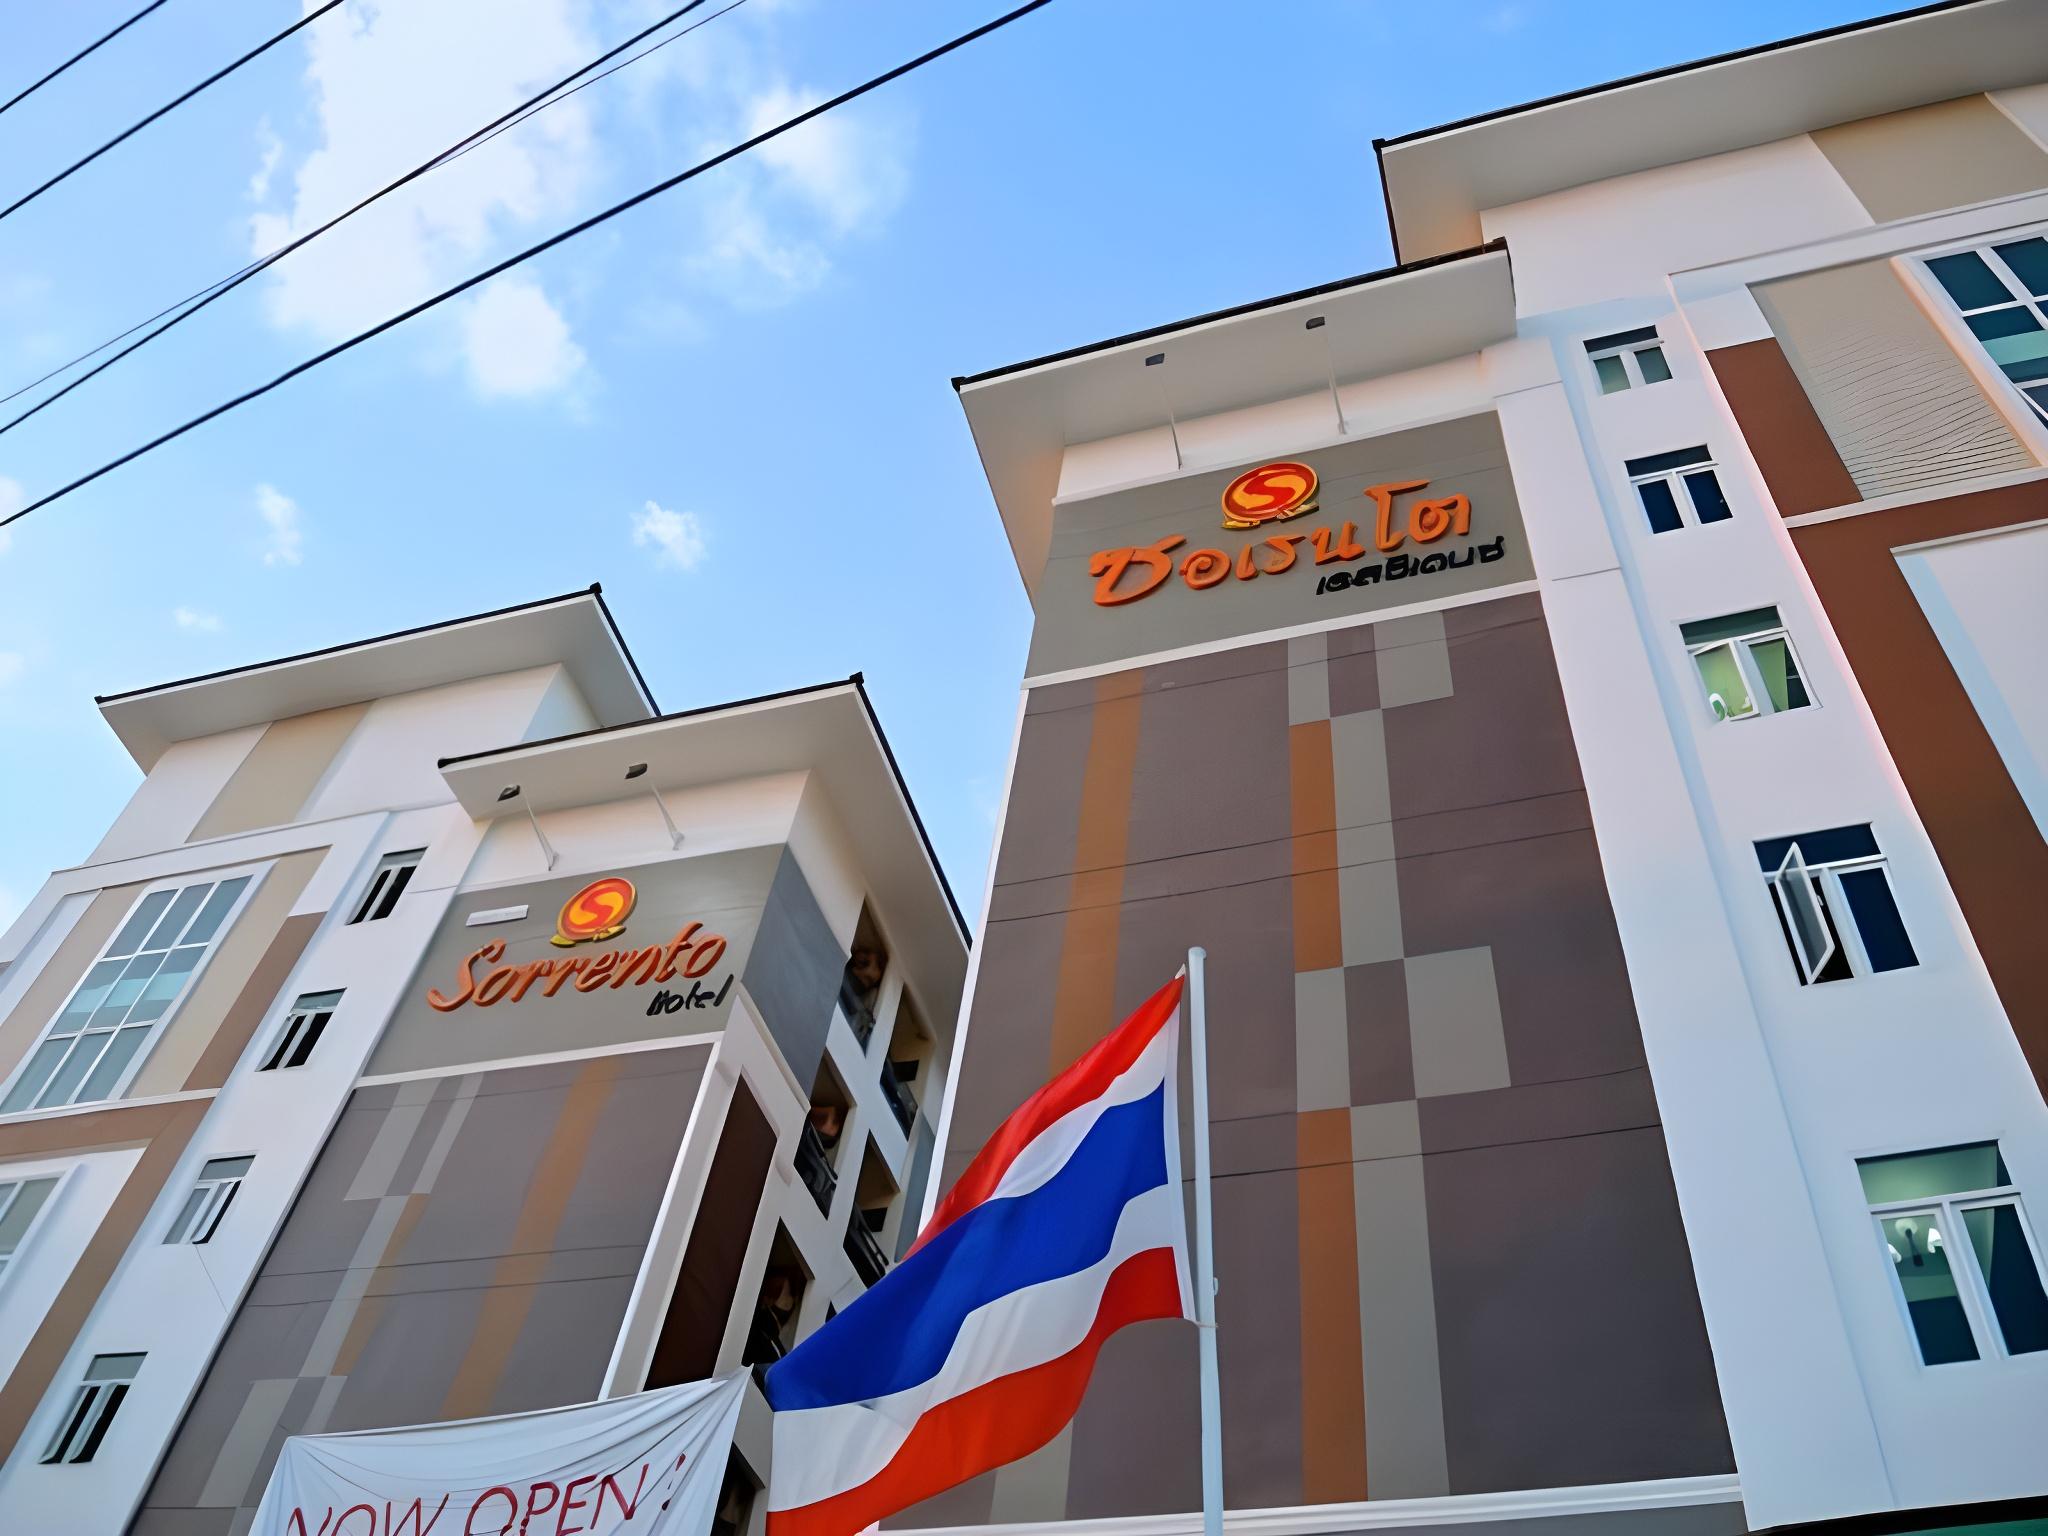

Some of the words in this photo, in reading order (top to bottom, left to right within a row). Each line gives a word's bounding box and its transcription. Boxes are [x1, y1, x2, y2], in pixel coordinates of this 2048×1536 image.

[1089, 479, 1473, 607] ซอเรนโต
[427, 921, 728, 1013] Sorrento
[646, 974, 735, 1017] Hotel
